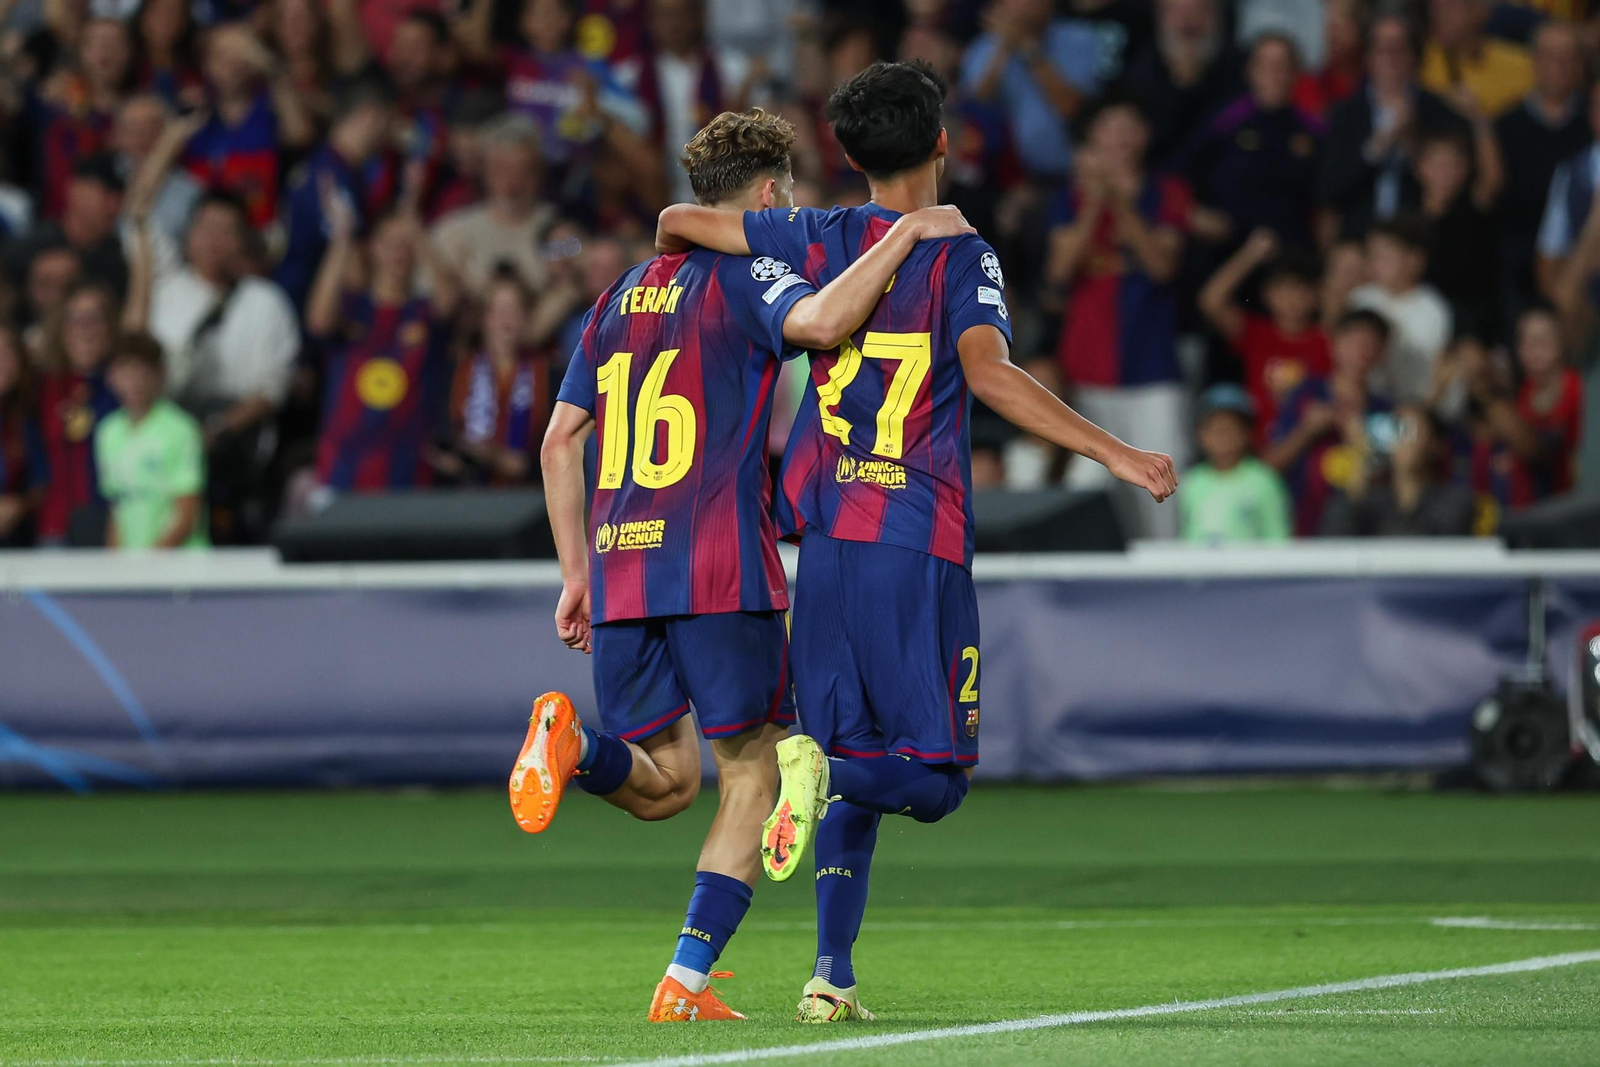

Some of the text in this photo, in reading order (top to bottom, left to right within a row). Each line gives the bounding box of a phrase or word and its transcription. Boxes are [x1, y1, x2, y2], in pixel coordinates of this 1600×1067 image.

[816, 331, 932, 459] 27
[597, 348, 697, 490] 16
[858, 460, 905, 473] UNHCR
[857, 467, 907, 485] ACNUR
[620, 519, 666, 534] UNHCR
[617, 530, 664, 546] ACNUR
[958, 646, 979, 703] 2
